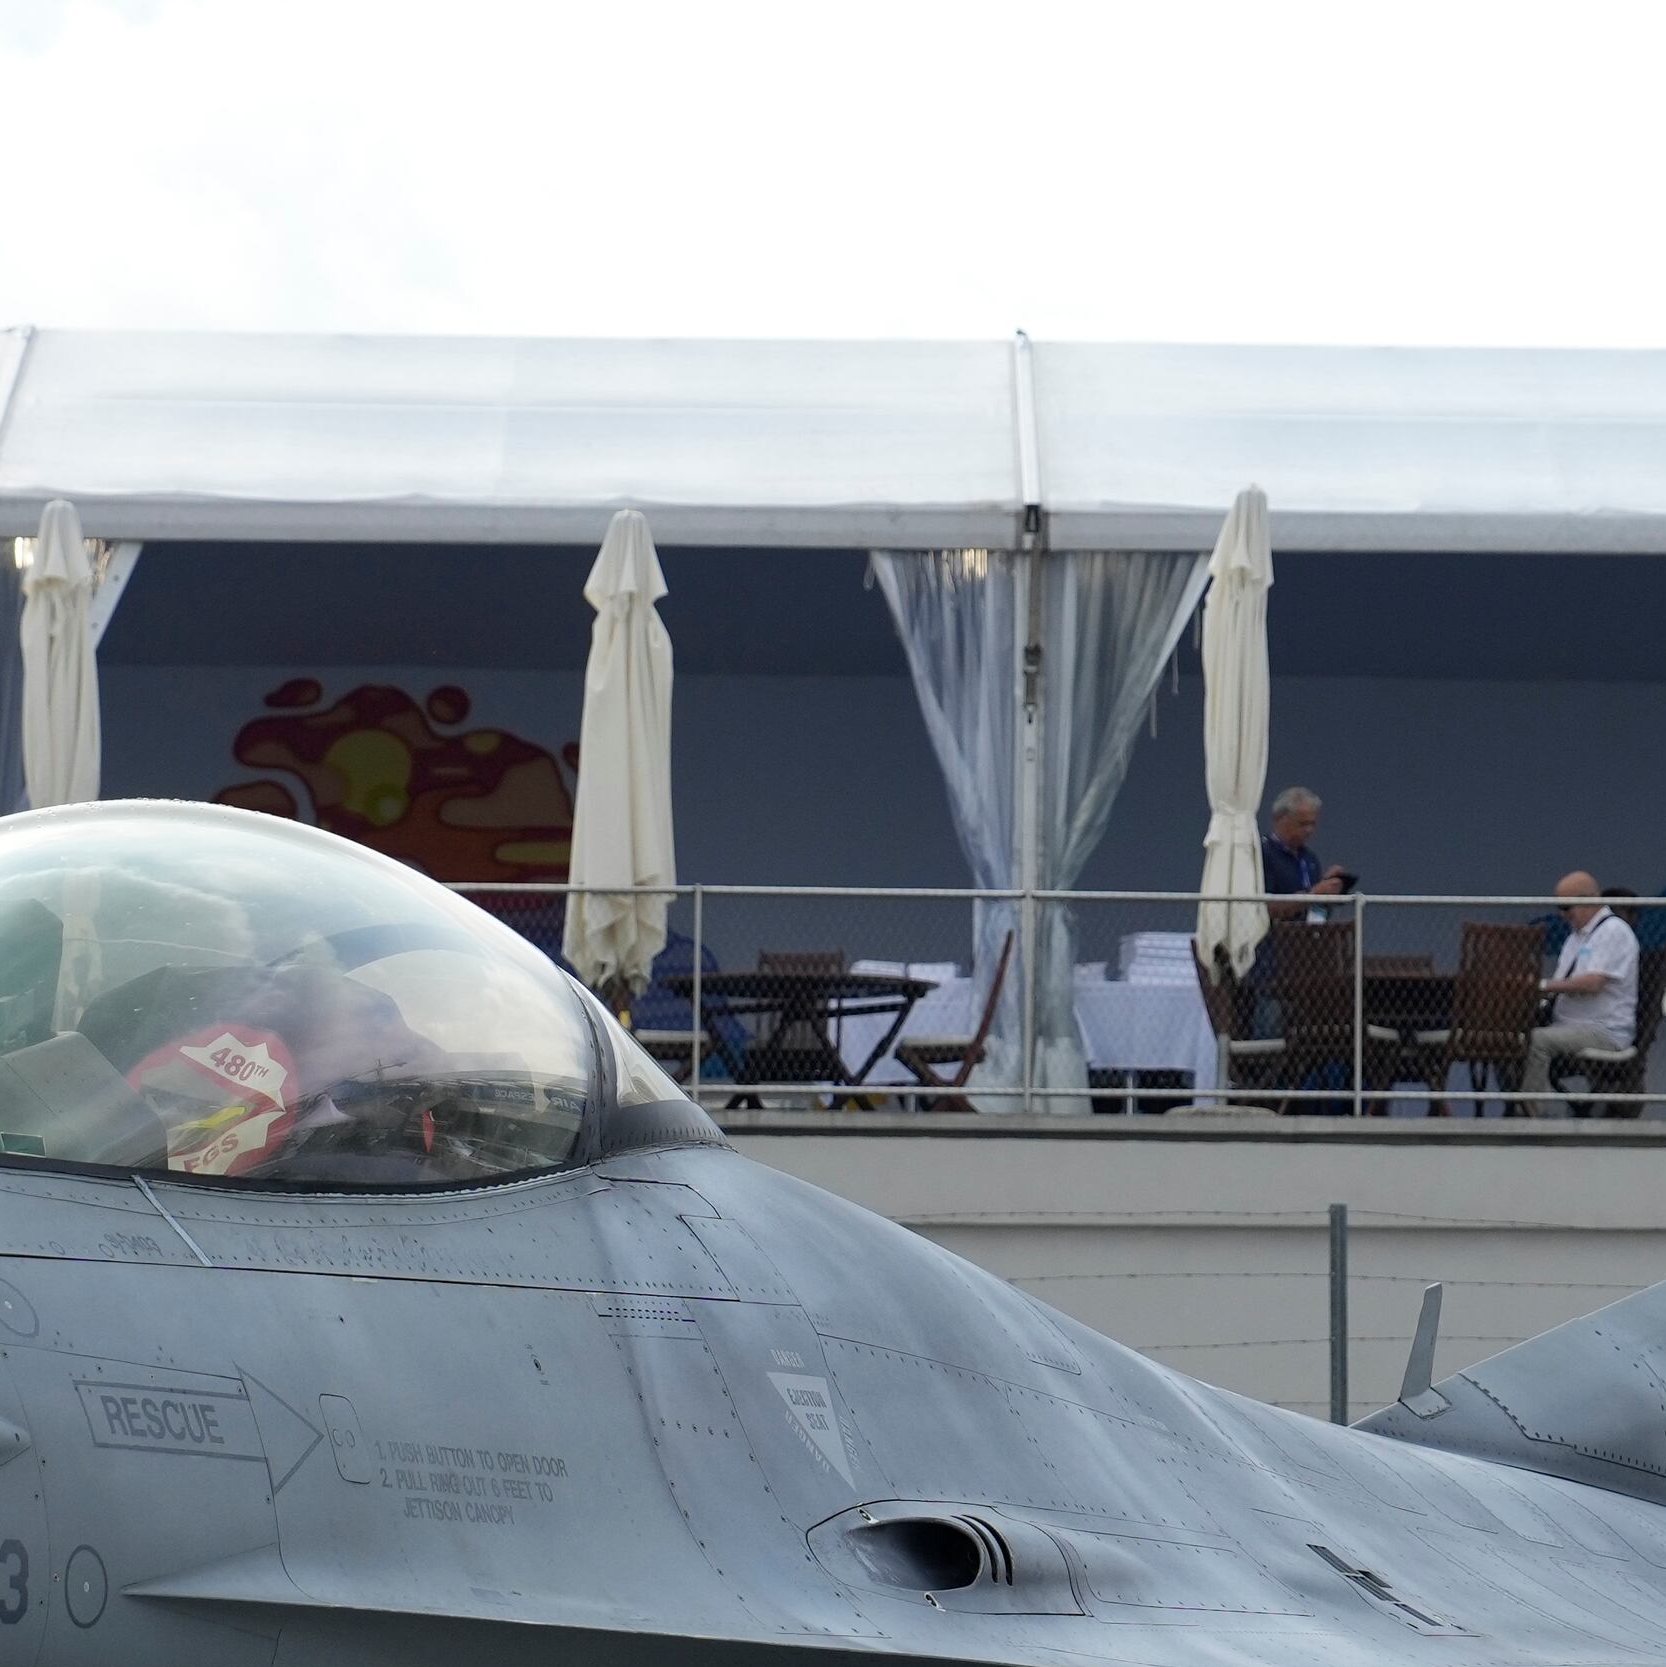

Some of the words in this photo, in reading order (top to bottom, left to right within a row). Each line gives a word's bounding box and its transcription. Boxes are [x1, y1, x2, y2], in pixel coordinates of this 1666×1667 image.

[770, 1349, 805, 1368] DANGER
[786, 1387, 827, 1408] EJECTION
[100, 1395, 225, 1445] RESCUE
[806, 1412, 830, 1431] SEAT
[388, 1441, 424, 1463] PUSH
[426, 1445, 475, 1468] BUTTON
[477, 1450, 494, 1470] TO
[497, 1452, 531, 1474] OPEN
[533, 1455, 568, 1477] DOOR
[396, 1469, 427, 1491] PULL
[430, 1473, 461, 1494] RING
[463, 1476, 487, 1497] OUT
[491, 1478, 501, 1497] 6
[502, 1479, 533, 1500] FEET
[535, 1482, 554, 1502] TO
[404, 1497, 463, 1522] JETTISON
[465, 1502, 515, 1525] CANOPY
